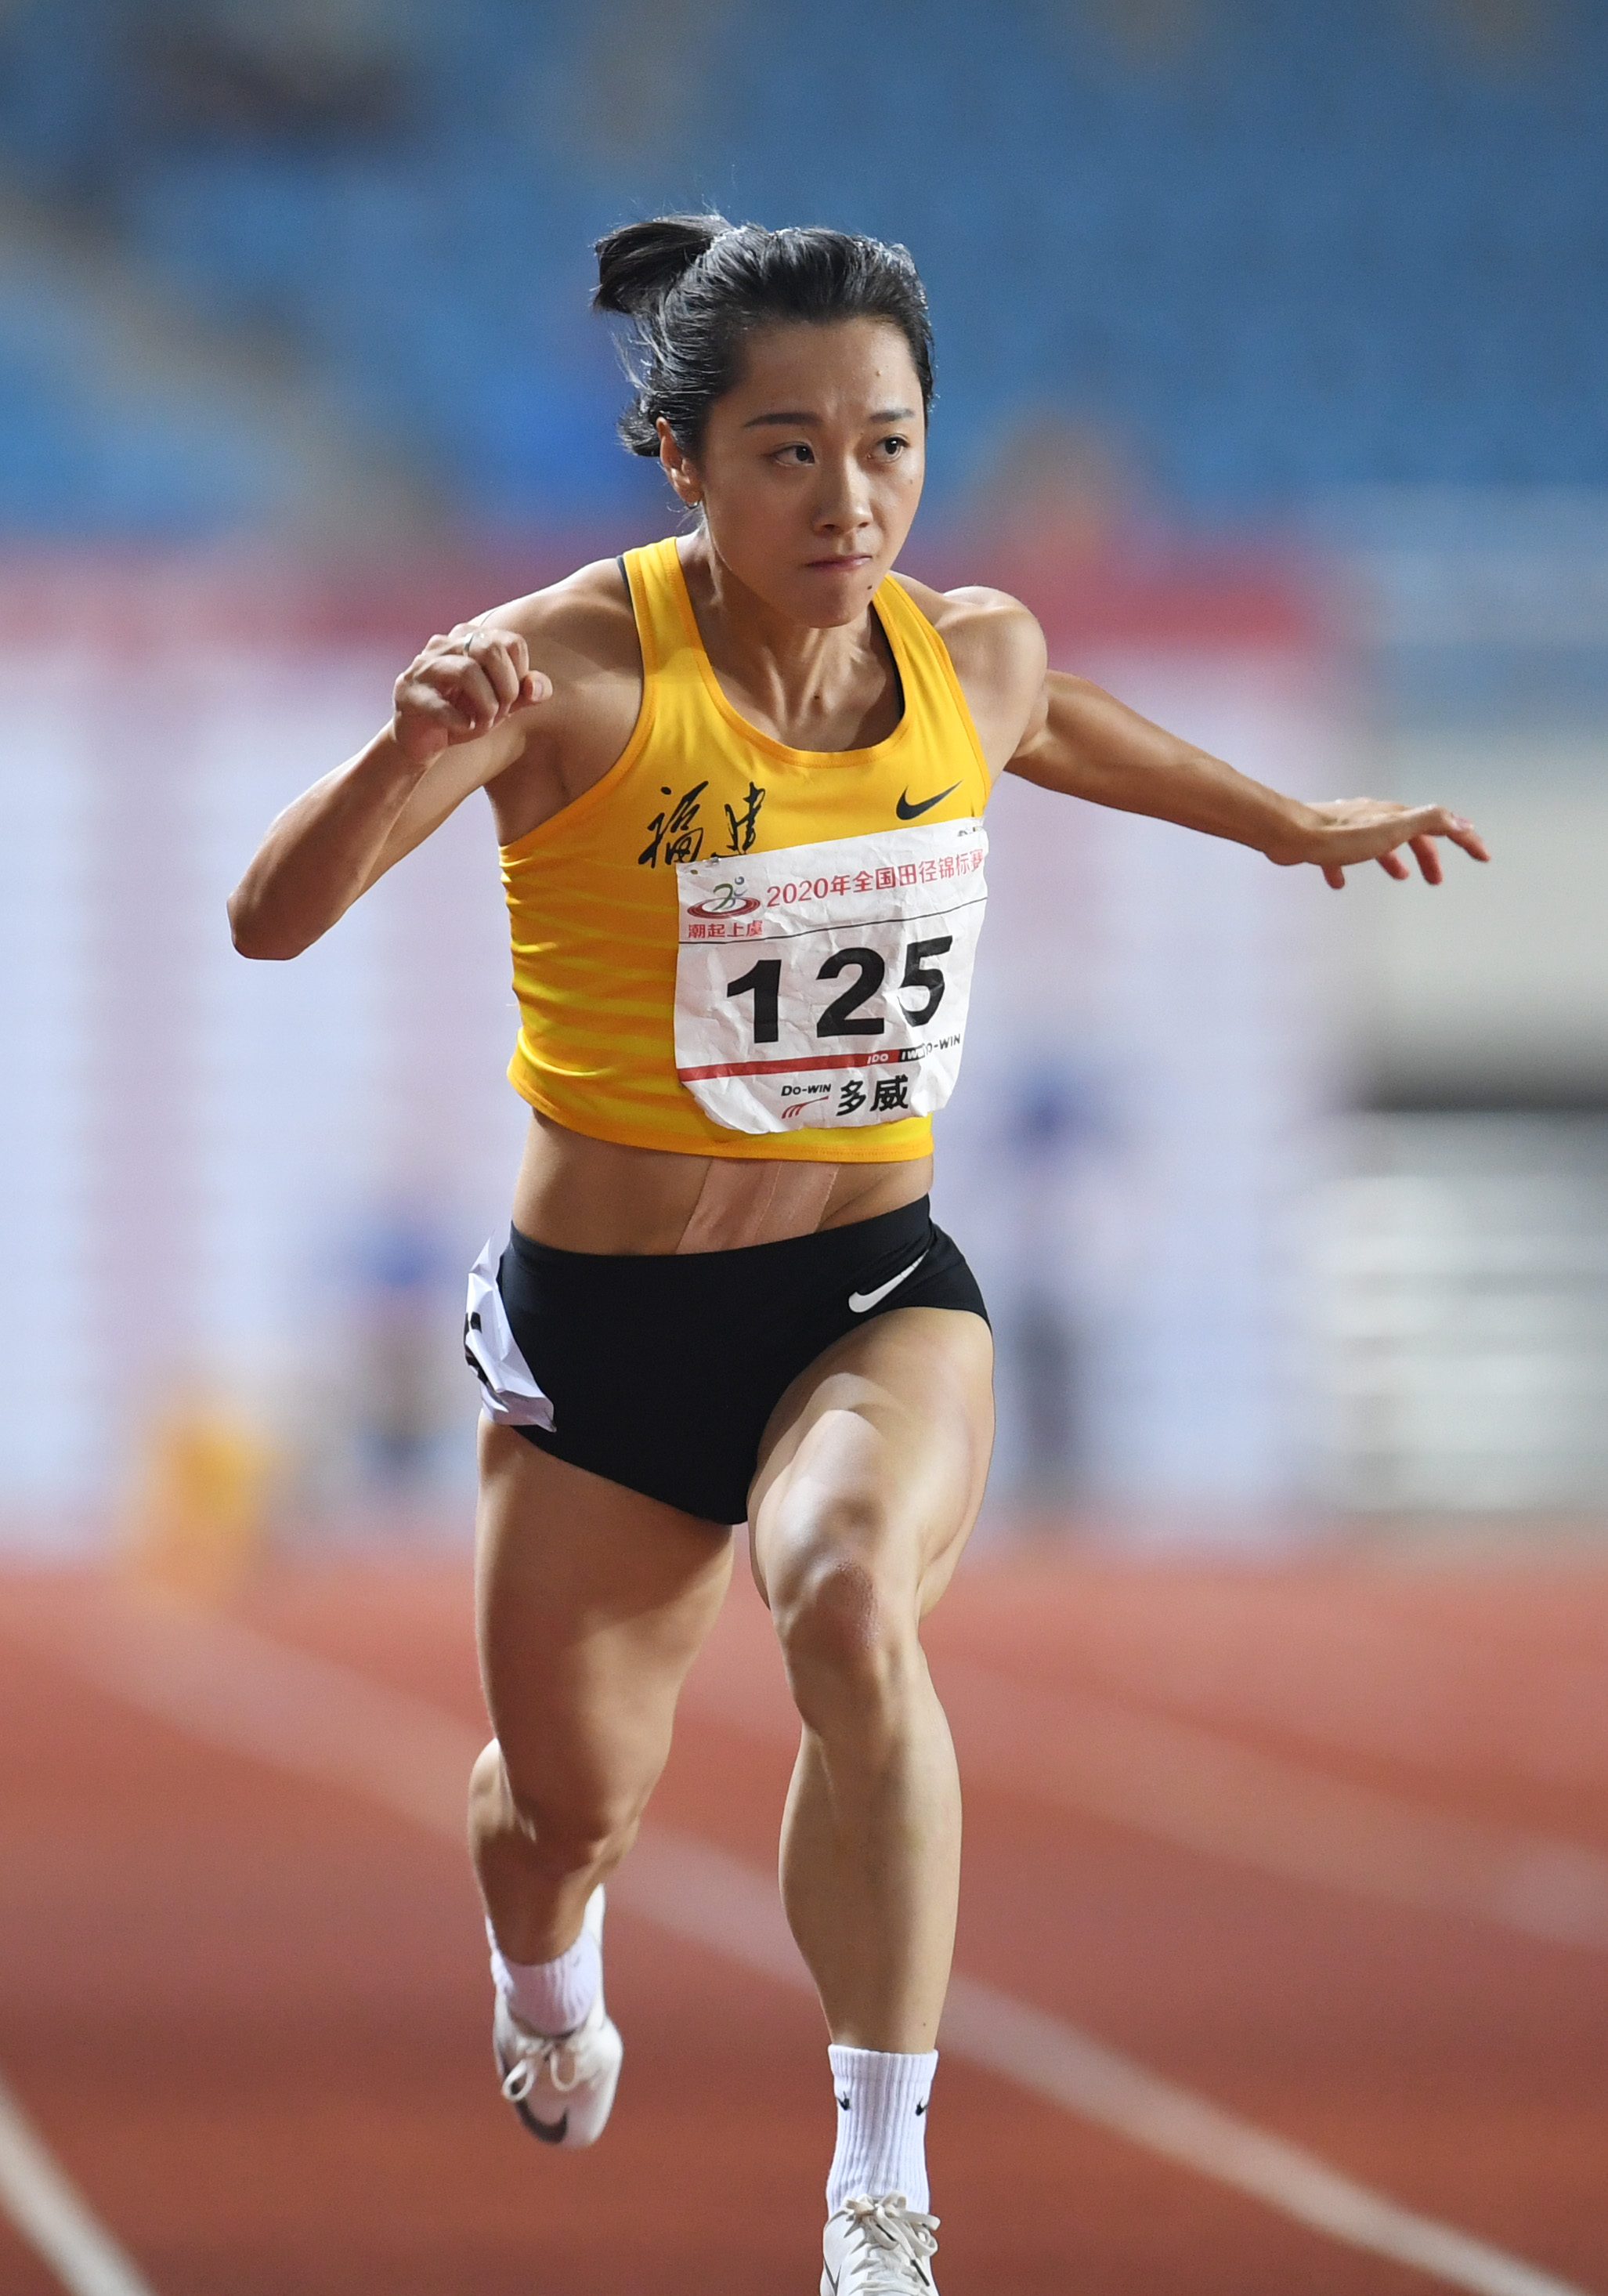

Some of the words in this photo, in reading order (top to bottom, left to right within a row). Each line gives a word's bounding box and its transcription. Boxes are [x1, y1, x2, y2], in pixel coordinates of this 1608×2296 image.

[766, 848, 984, 908] 2020年全国田径锦标赛
[688, 920, 763, 938] 潮起上虞
[727, 935, 953, 1043] 125
[836, 1074, 909, 1116] 多威
